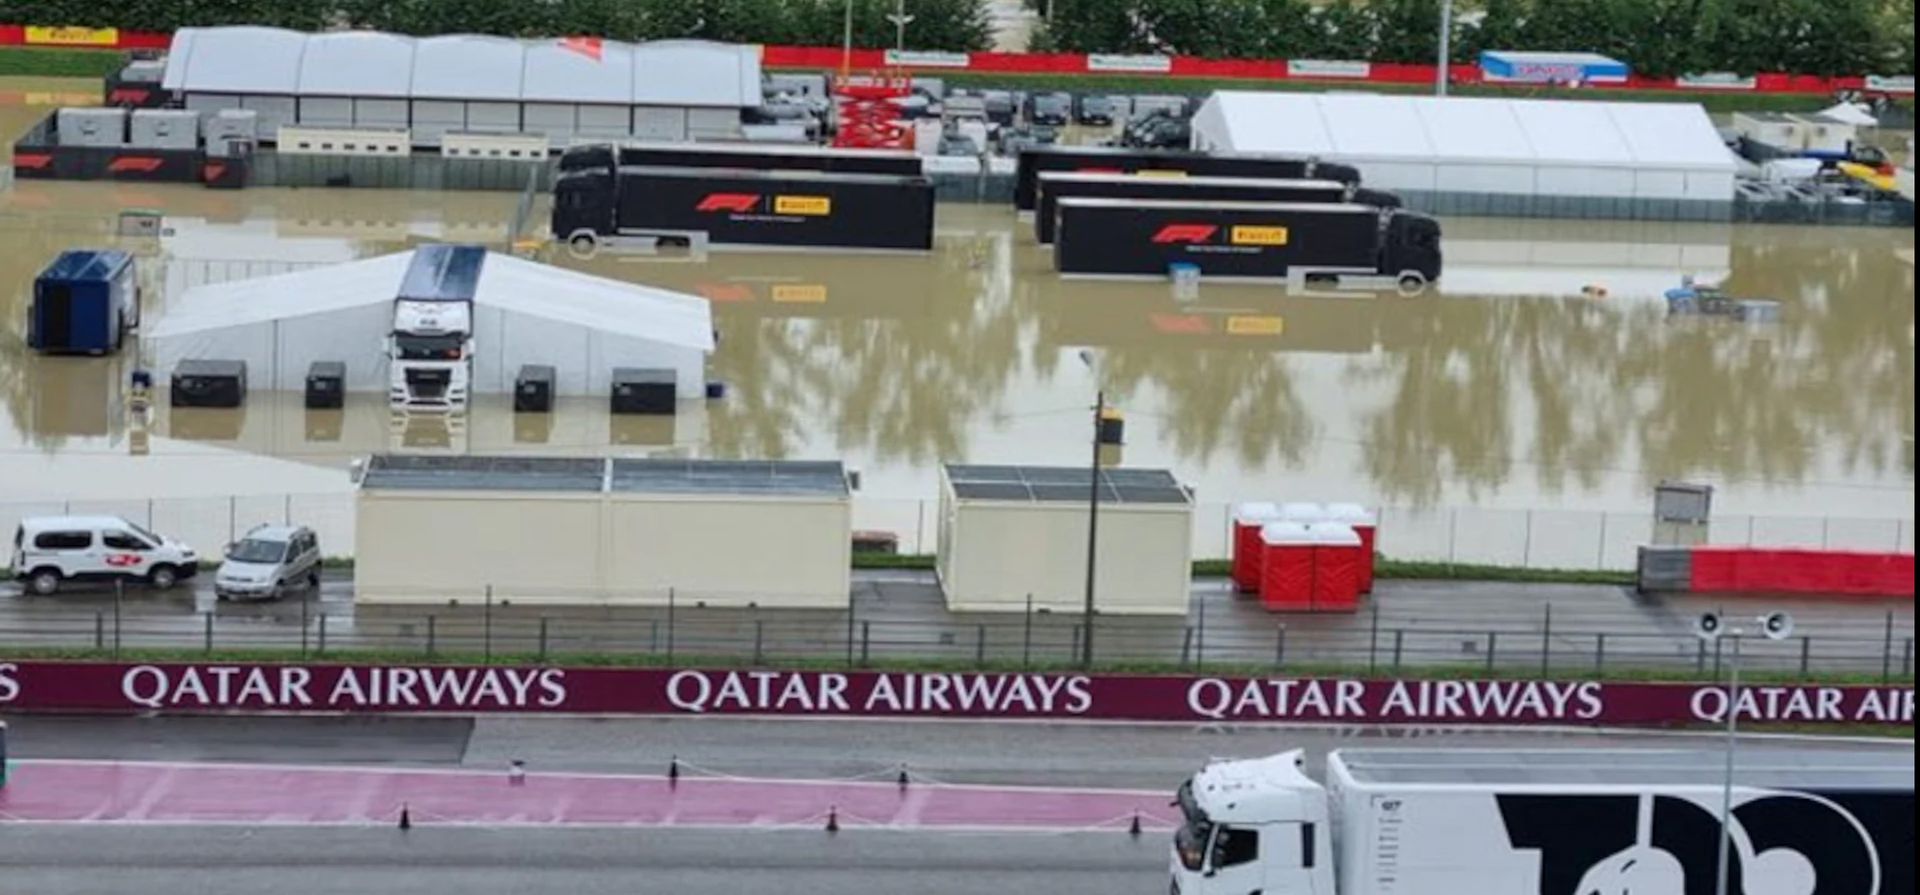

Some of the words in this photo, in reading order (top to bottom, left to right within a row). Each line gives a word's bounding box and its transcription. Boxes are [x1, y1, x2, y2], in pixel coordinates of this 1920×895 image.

[122, 665, 313, 707] QATAR
[328, 667, 566, 706] AIRWAYS
[666, 670, 850, 712] QATAR
[864, 673, 1093, 713] AIRWAYS
[1187, 678, 1366, 719] QATAR
[1380, 680, 1603, 719] AIRWAYS
[1690, 686, 1845, 723] QATAR
